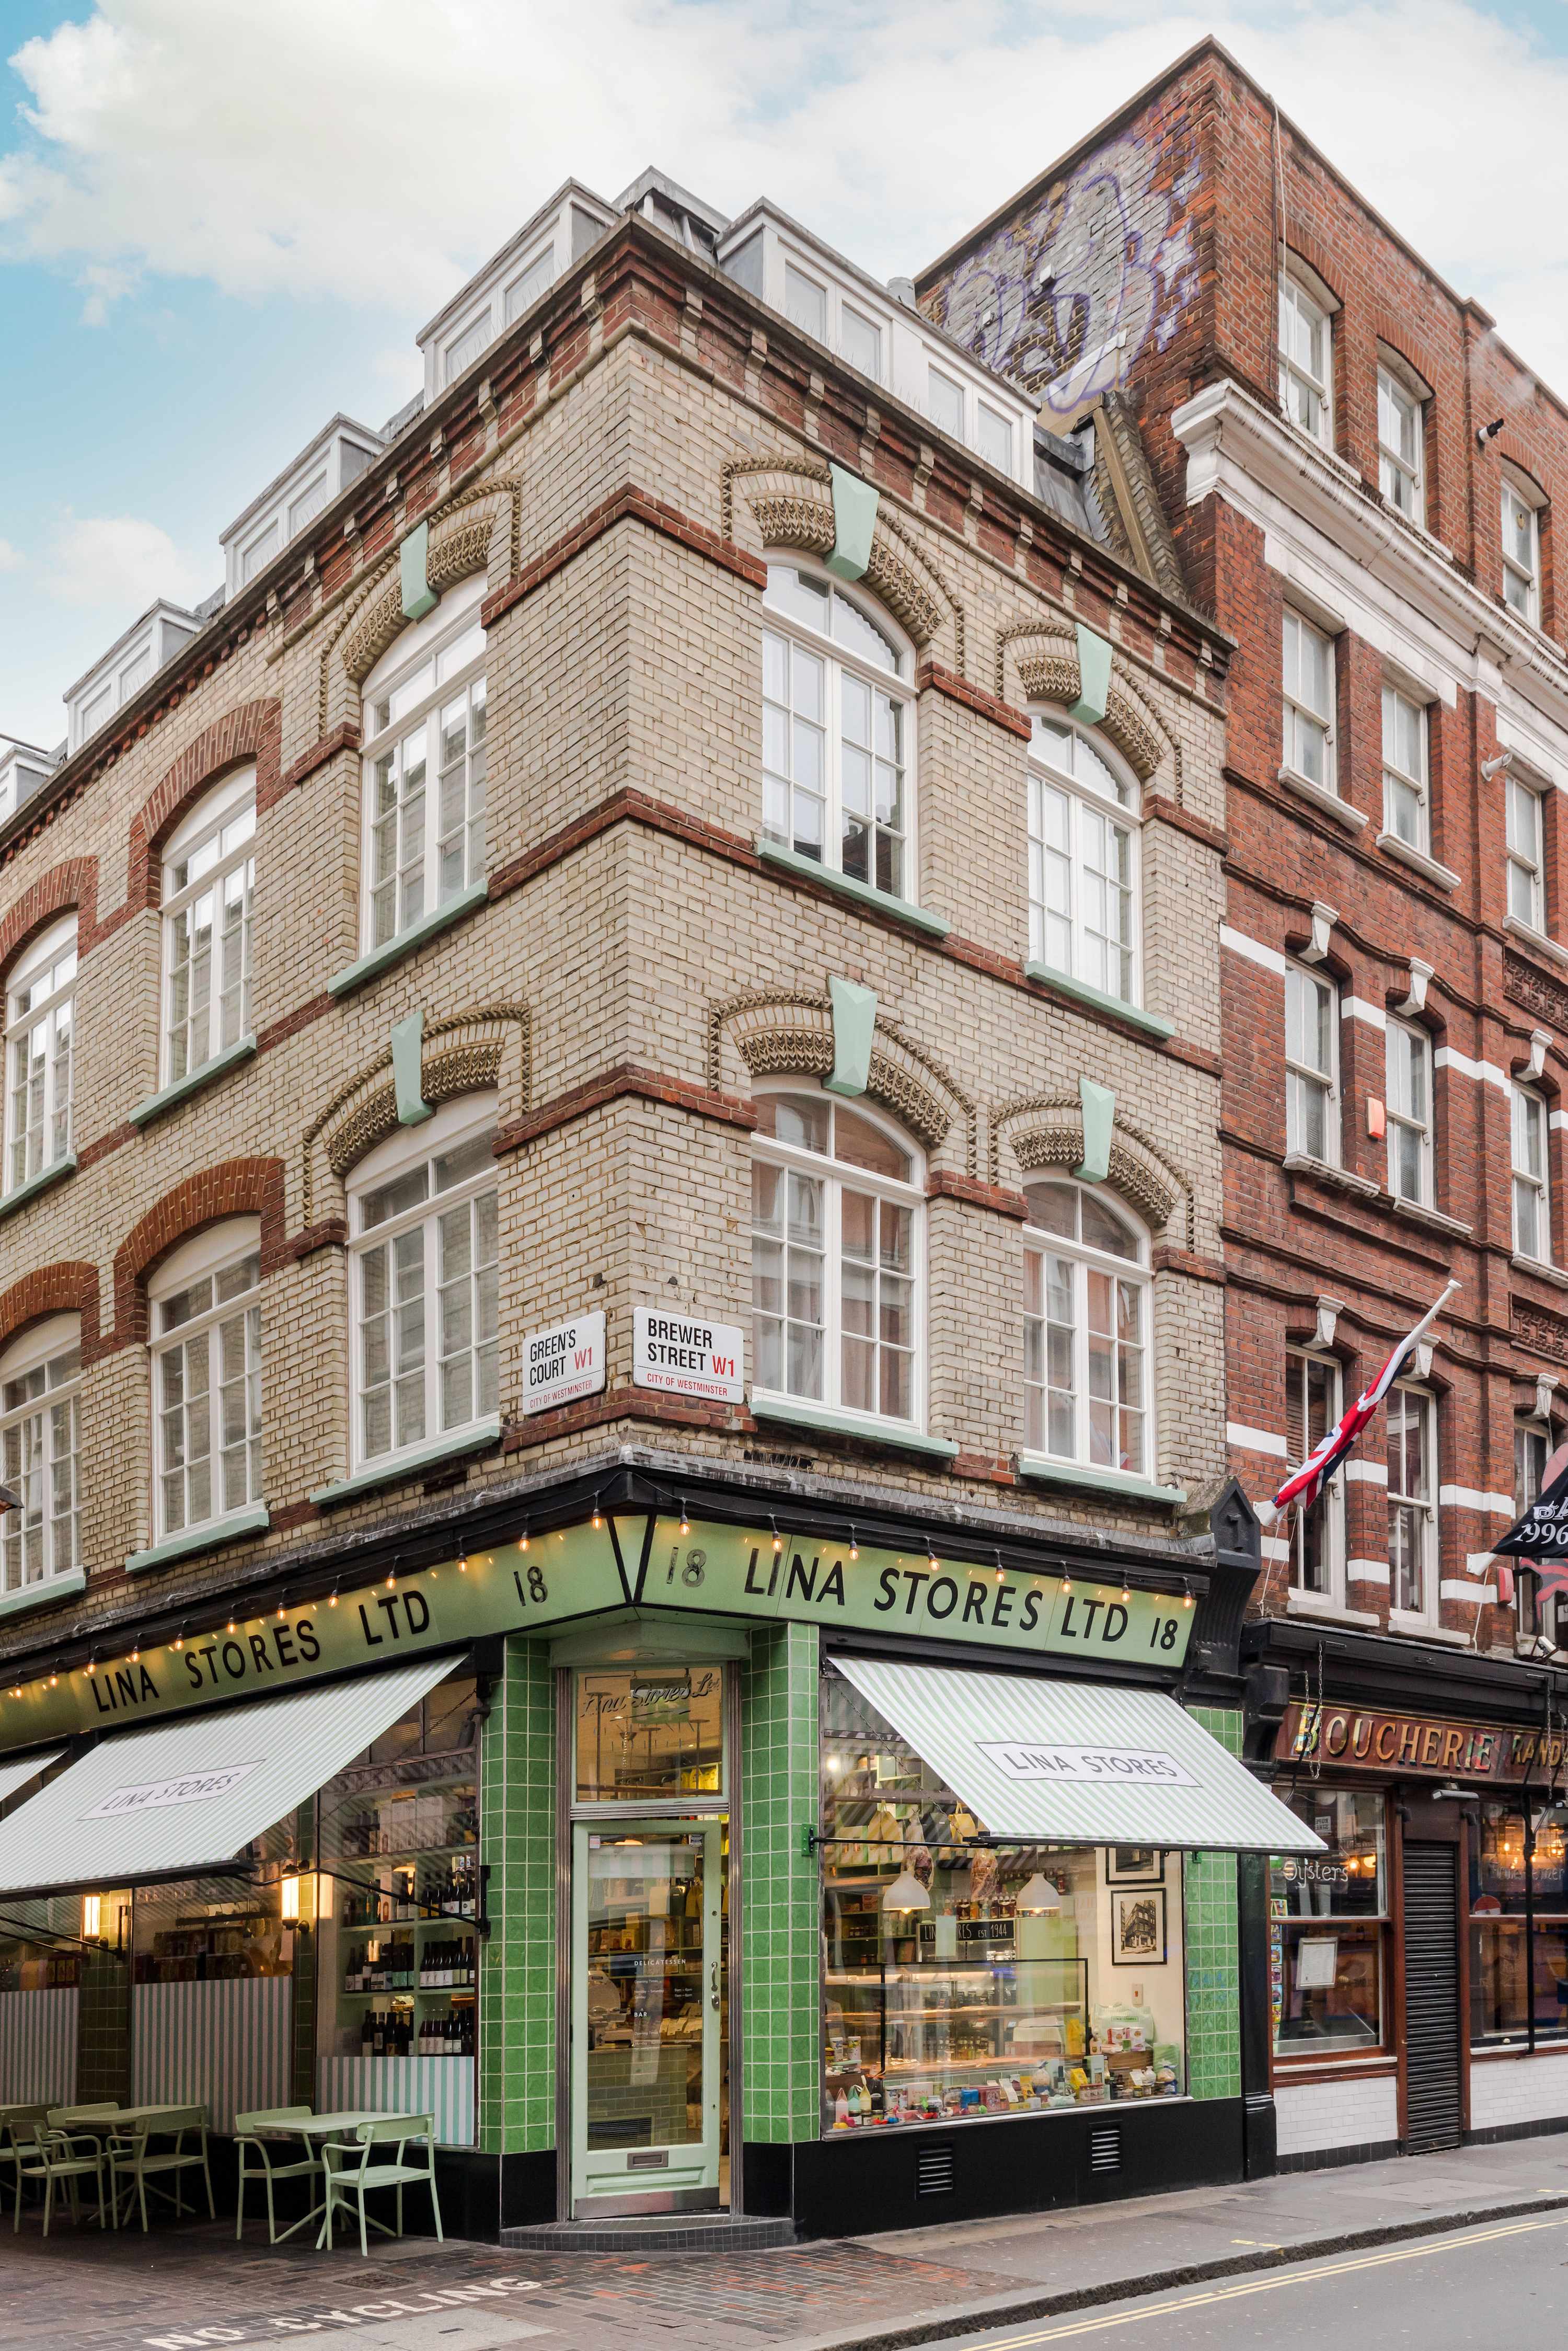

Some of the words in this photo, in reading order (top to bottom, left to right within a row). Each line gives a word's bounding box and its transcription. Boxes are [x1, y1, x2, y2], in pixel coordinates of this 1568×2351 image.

[530, 1329, 576, 1362] GREEN'S
[648, 1317, 712, 1349] BREWER
[529, 1356, 567, 1386] COURT
[574, 1346, 592, 1370] W1
[648, 1343, 707, 1371] STREET
[712, 1355, 734, 1377] W1
[529, 1395, 542, 1408] CITY
[544, 1394, 551, 1405] OF
[552, 1380, 592, 1401] WESTMINSTER
[647, 1373, 663, 1384] CITY
[666, 1375, 675, 1386] OF
[677, 1378, 728, 1396] WESTMINSTER
[1514, 1522, 1568, 1545] 1996
[666, 1546, 707, 1588] 18
[744, 1547, 845, 1606] LINA
[873, 1567, 1043, 1632] STORES
[1060, 1596, 1128, 1643] LTD
[1149, 1618, 1178, 1650] 18
[90, 1664, 159, 1713] LINA
[185, 1619, 320, 1689] STORES
[358, 1590, 430, 1646] LTD
[513, 1565, 548, 1607] 18
[1293, 1708, 1496, 1773] BOUCHERIE
[1003, 1752, 1077, 1772] LINA
[1081, 1756, 1178, 1777] STORES
[101, 1790, 151, 1810] LINA
[156, 1772, 241, 1799] STORES
[1283, 1860, 1349, 1888] Oysters
[925, 1925, 936, 1940] LIN
[990, 1923, 1008, 1937] 1944
[142, 2327, 246, 2351] NO
[267, 2276, 544, 2330] CYCLING
